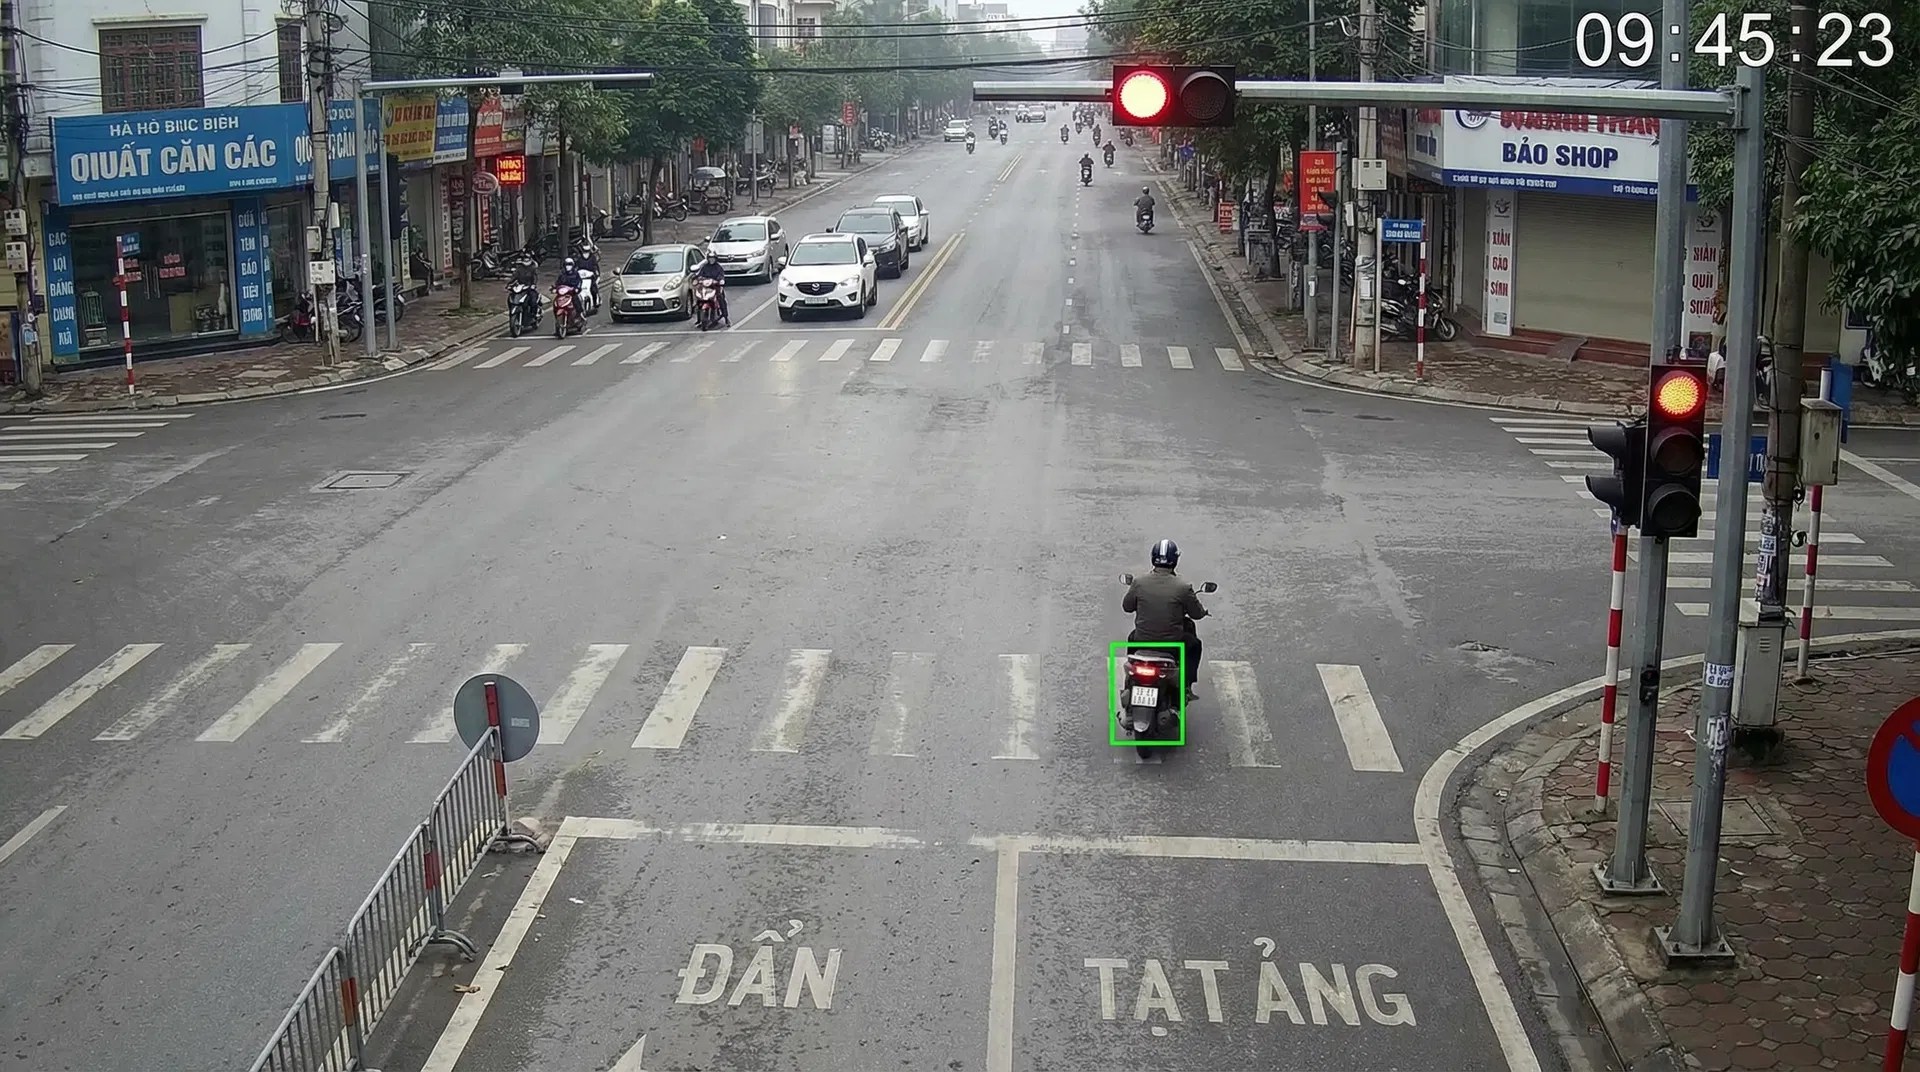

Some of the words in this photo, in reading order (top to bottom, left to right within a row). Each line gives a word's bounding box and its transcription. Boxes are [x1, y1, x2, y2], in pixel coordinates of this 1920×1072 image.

[160, 138, 215, 175] CĂN
[224, 134, 277, 170] CÁC
[1502, 136, 1548, 165] BẢO
[1556, 144, 1618, 169] SHOP
